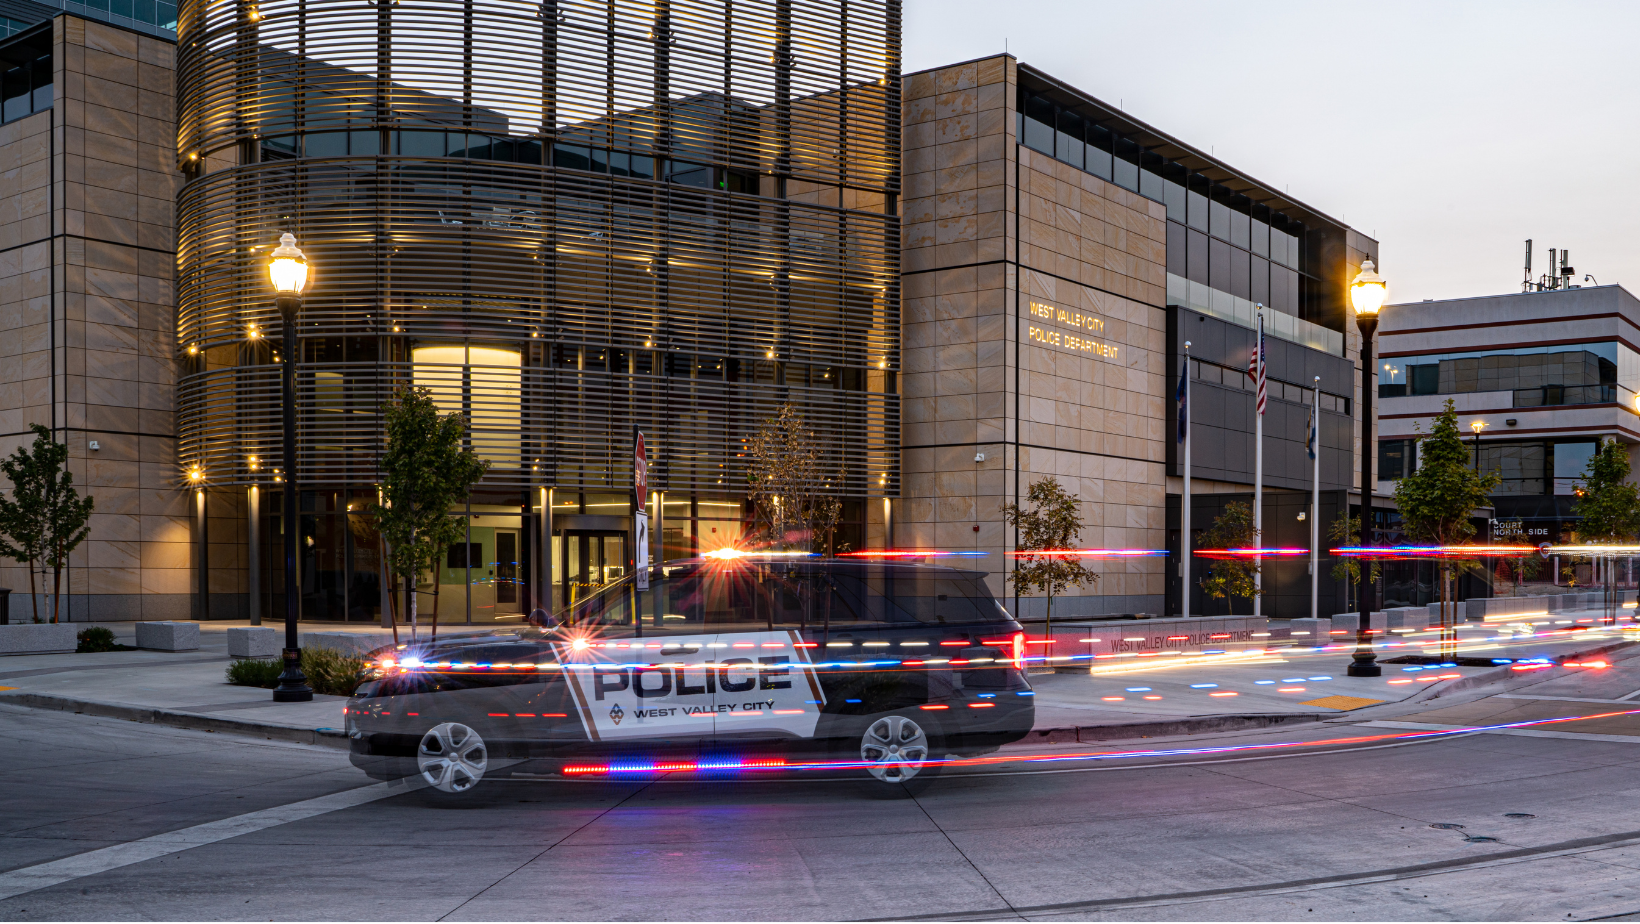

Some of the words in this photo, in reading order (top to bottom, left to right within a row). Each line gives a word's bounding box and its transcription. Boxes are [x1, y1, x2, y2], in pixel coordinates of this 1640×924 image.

[1029, 301, 1055, 320] WEST
[1056, 308, 1087, 328] VALLEY
[1087, 316, 1105, 332] CITY
[1029, 326, 1061, 346] POLICE
[1064, 335, 1119, 359] DEPARTMENT
[1493, 528, 1523, 536] NORTH
[1111, 638, 1133, 652] WEST
[1136, 636, 1164, 651] VALLEY
[1166, 635, 1184, 648] CITY
[1184, 632, 1210, 647] POLICE
[1211, 629, 1255, 644] DEPARTMENT
[593, 655, 792, 701] POLICE
[633, 707, 678, 719] WEST
[682, 703, 738, 716] VALLEY
[742, 700, 775, 712] CITY
